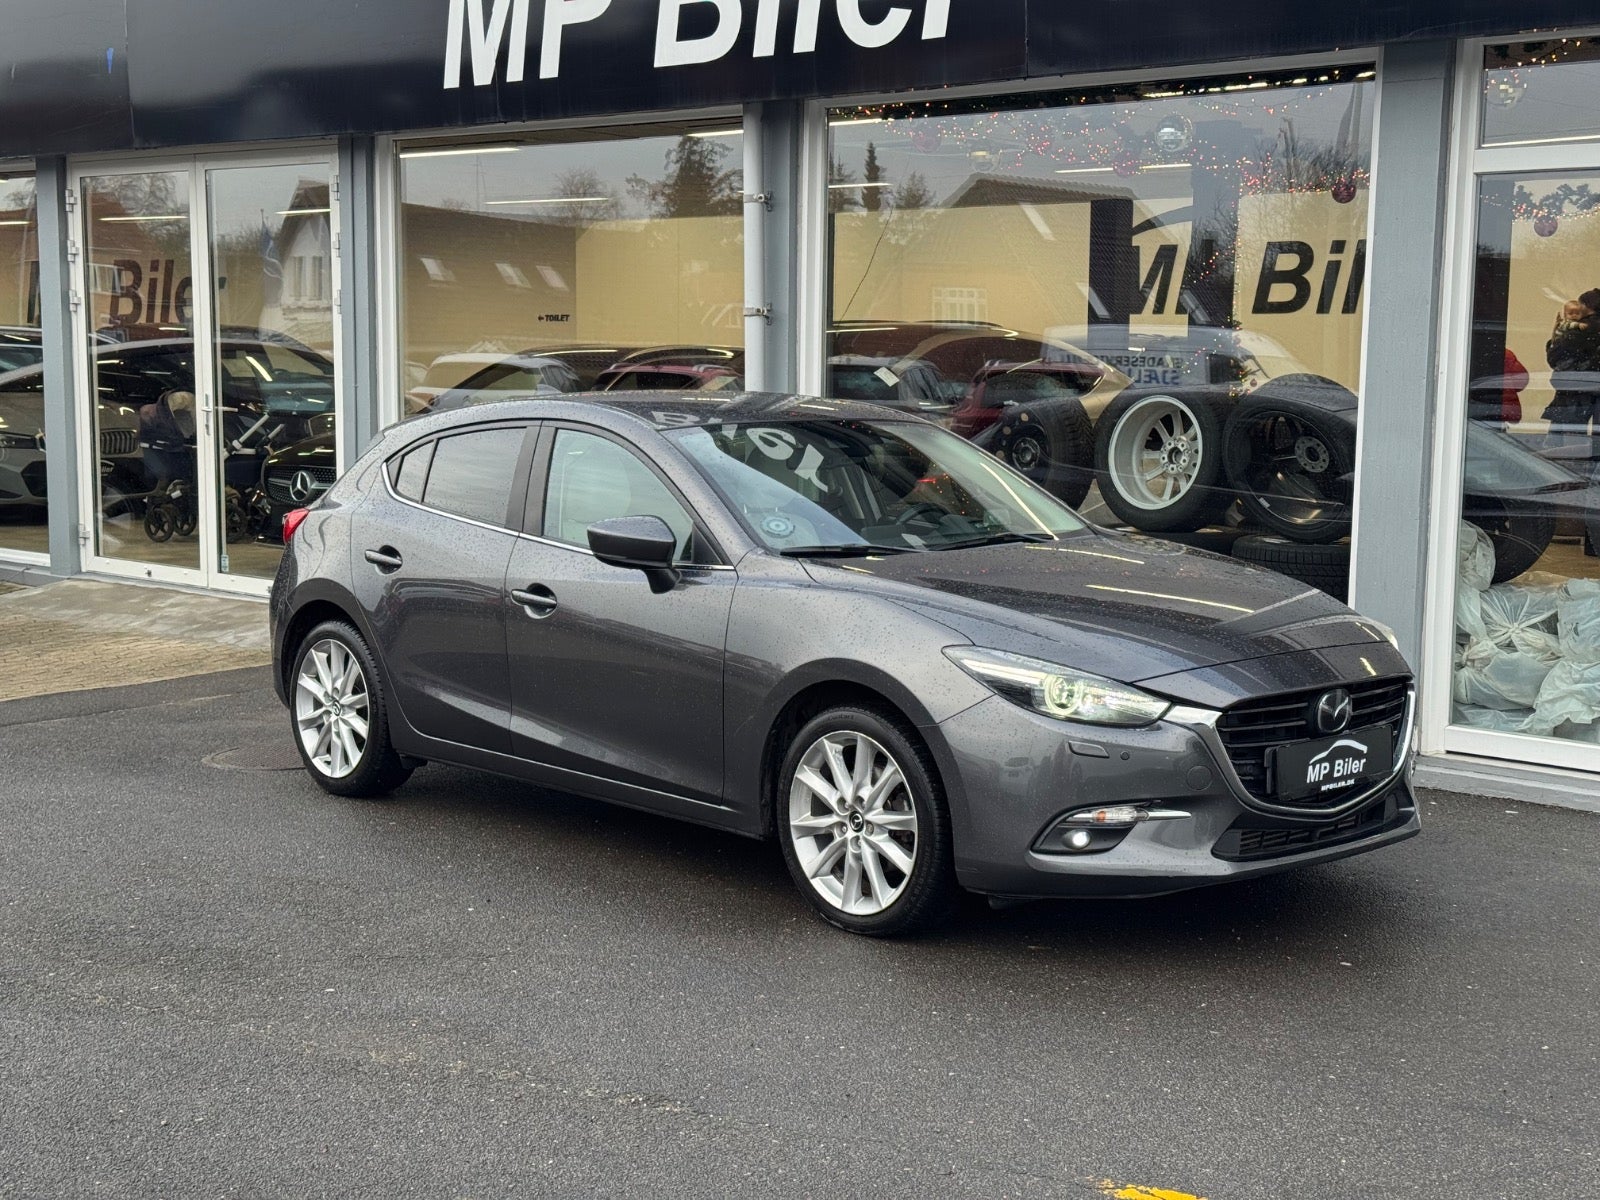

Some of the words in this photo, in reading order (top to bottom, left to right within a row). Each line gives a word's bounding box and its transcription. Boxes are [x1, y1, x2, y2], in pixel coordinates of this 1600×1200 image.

[108, 259, 227, 324] Bile
[544, 314, 570, 322] TOILET
[1307, 762, 1330, 783] MP
[1333, 757, 1366, 777] Biler
